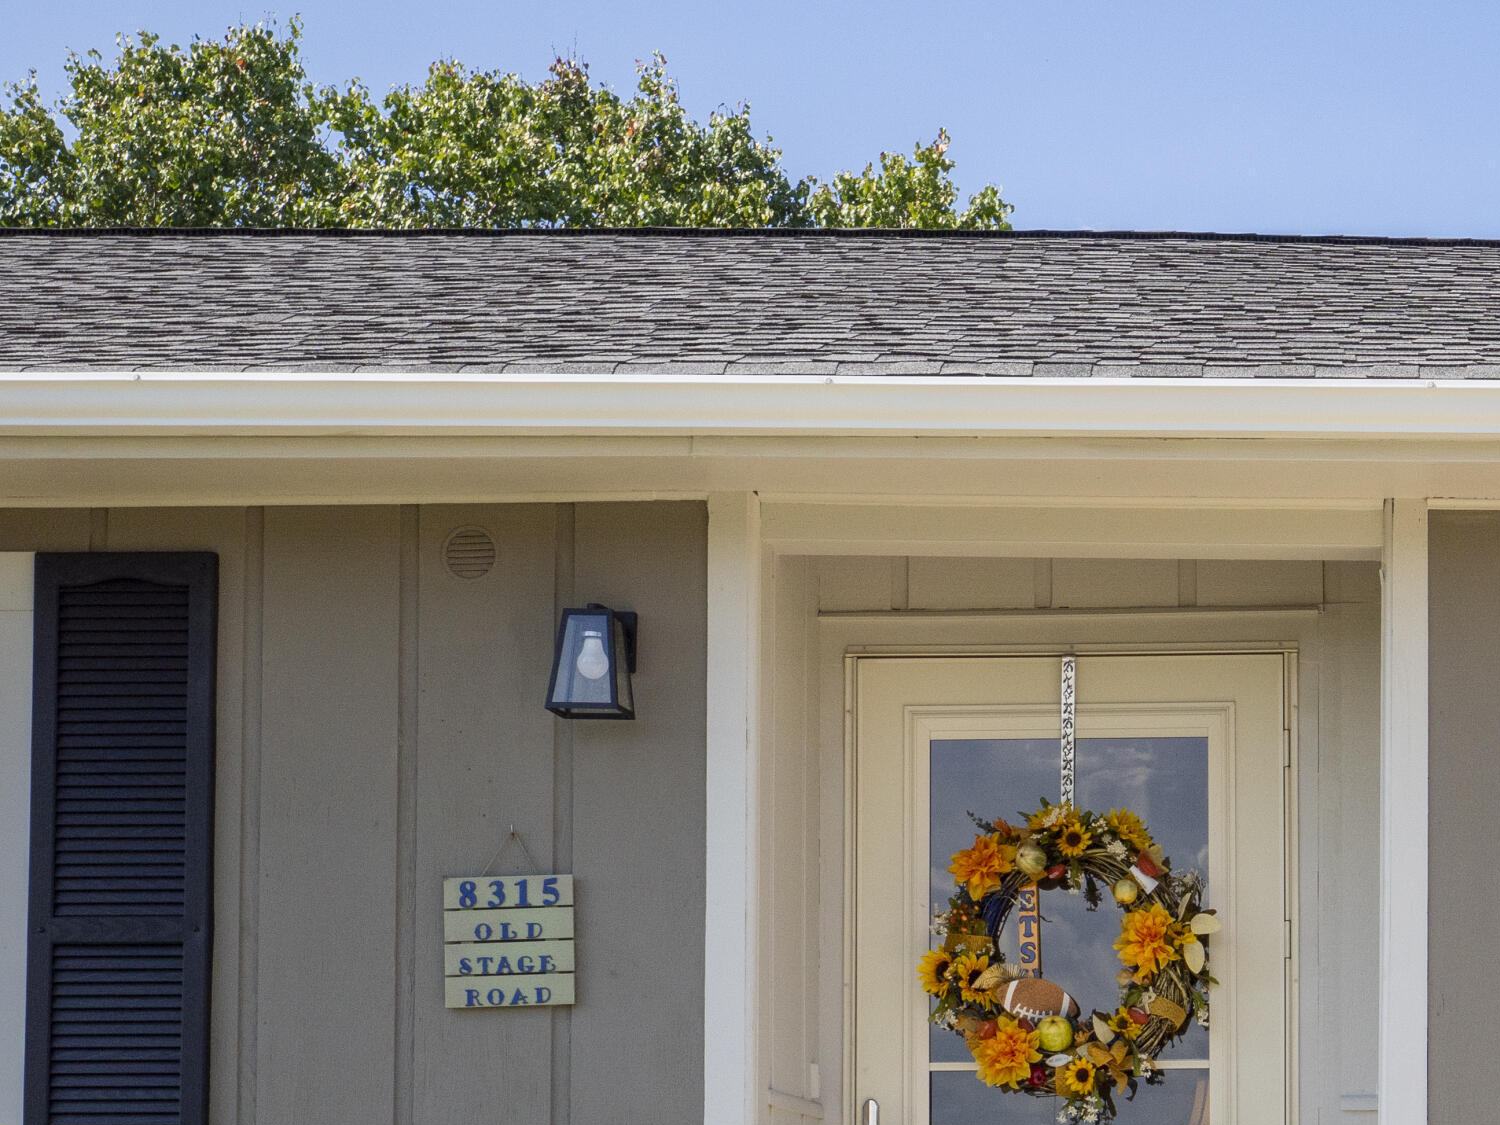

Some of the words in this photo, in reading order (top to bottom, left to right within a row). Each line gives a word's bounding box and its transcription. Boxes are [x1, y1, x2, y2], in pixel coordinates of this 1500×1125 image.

[459, 877, 560, 908] 8315
[474, 922, 543, 940] OLD
[459, 955, 556, 975] STAGE
[465, 987, 552, 1007] ROAD
